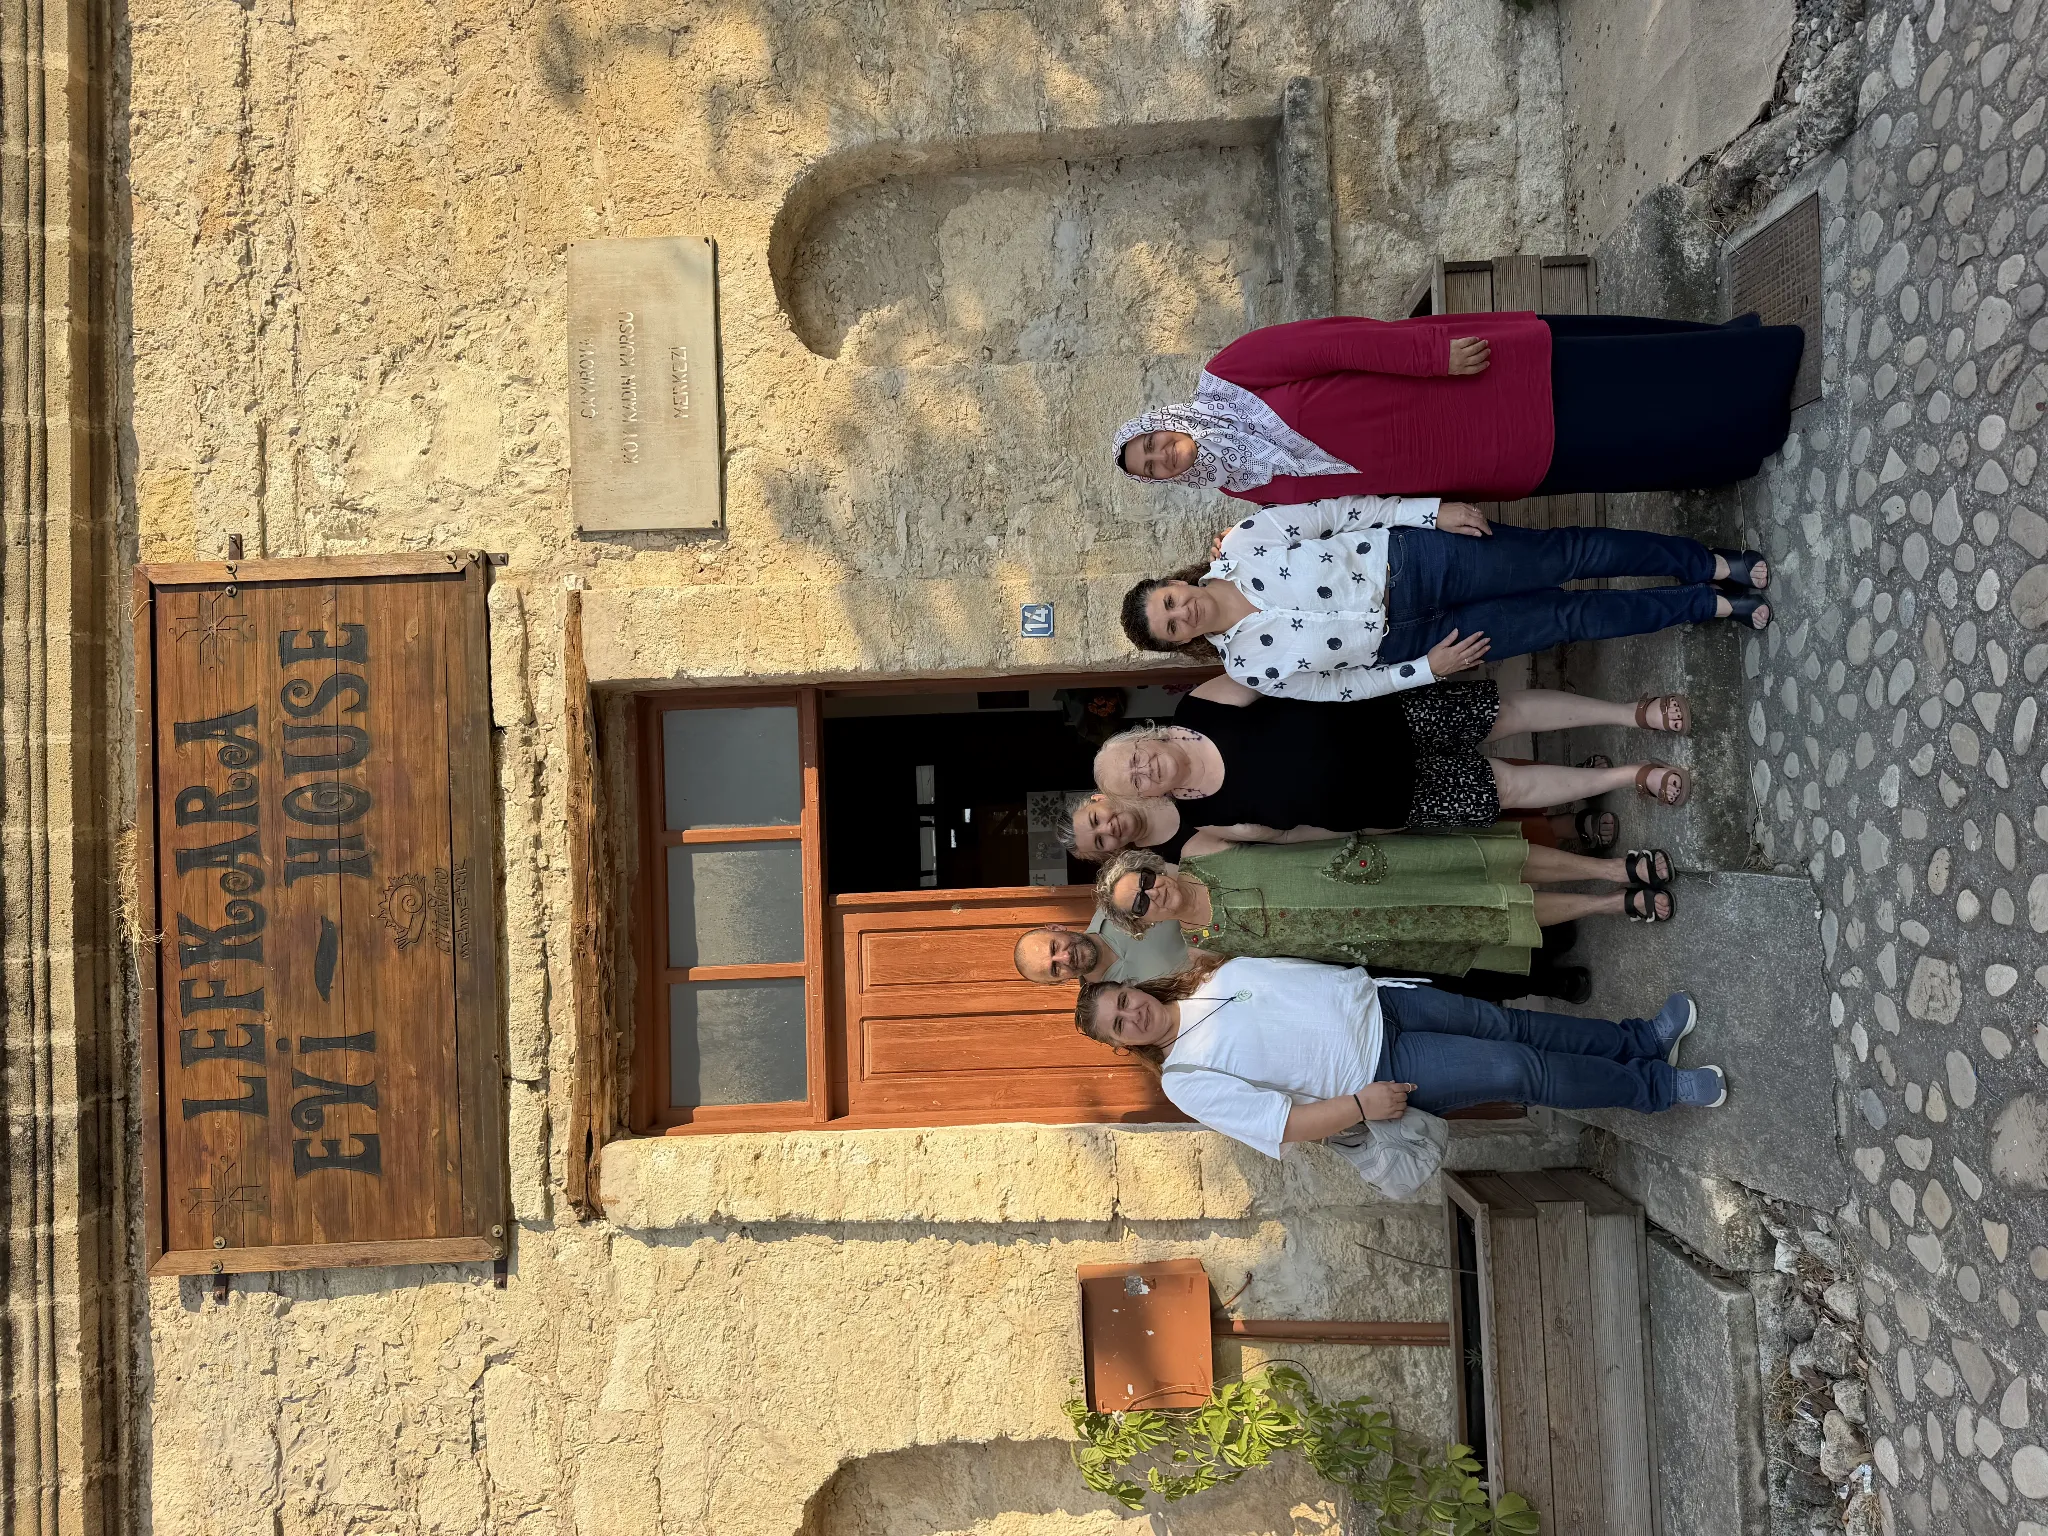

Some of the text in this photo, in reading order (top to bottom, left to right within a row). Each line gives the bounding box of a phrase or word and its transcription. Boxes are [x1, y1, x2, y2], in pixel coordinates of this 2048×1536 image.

[617, 311, 635, 367] KURSU
[577, 337, 599, 419] ÇAYIROVA
[620, 374, 638, 423] KADIN
[667, 345, 689, 419] MERKEZİ
[1024, 607, 1049, 632] 14
[278, 622, 373, 887] HOUSE
[173, 704, 268, 1121] LEFKARA
